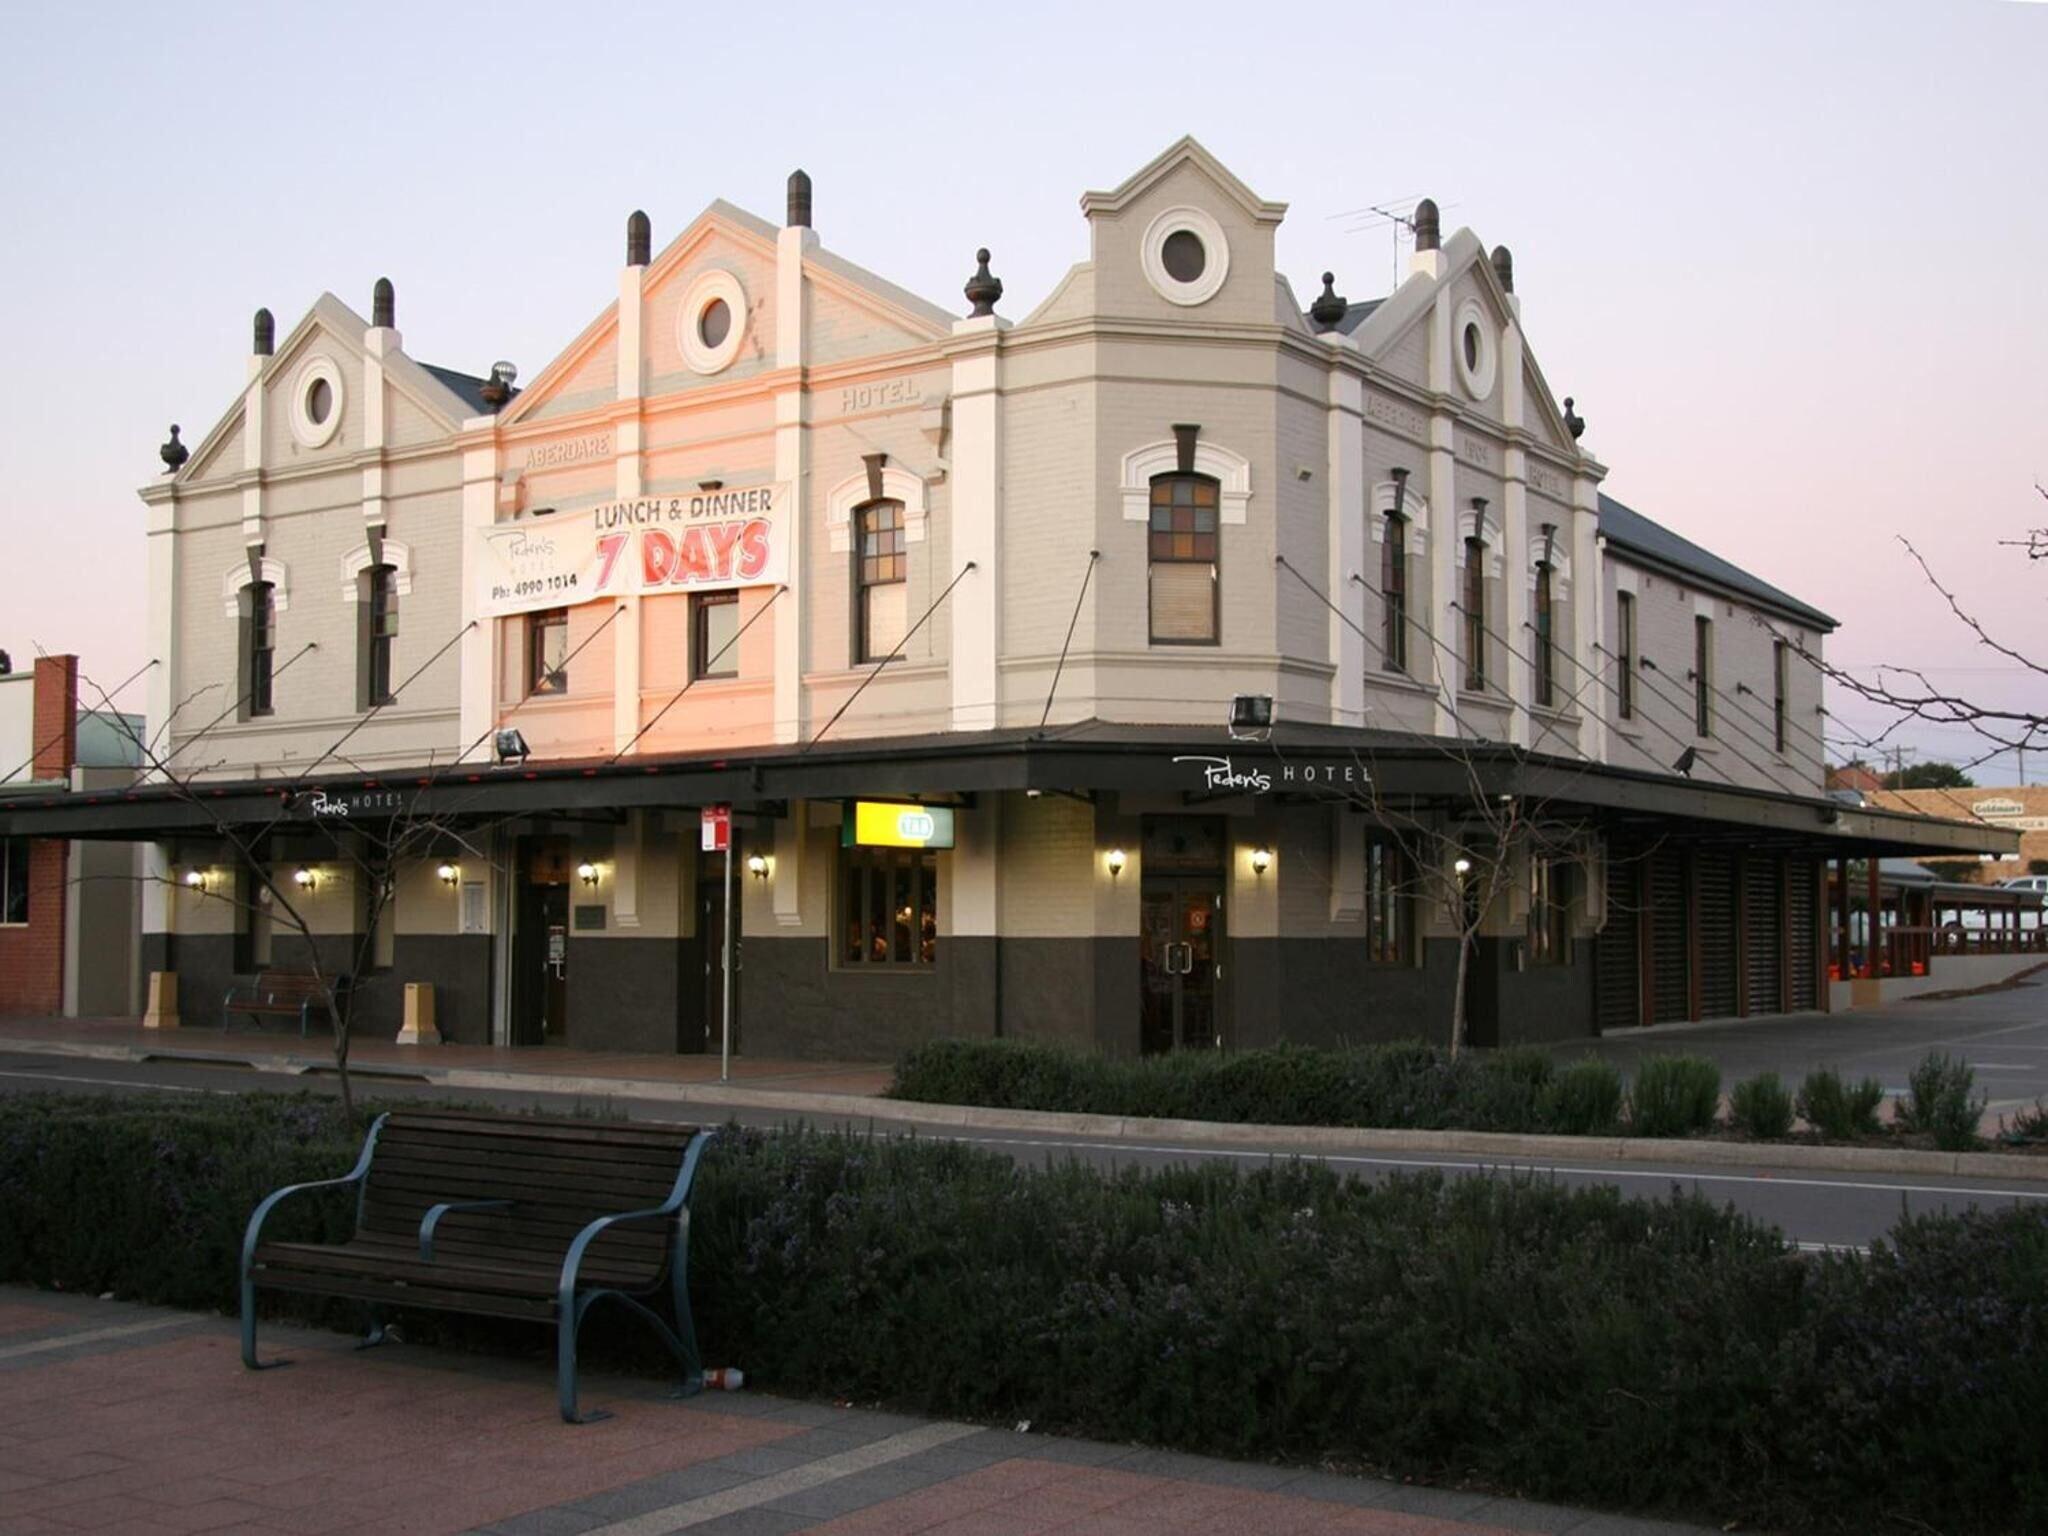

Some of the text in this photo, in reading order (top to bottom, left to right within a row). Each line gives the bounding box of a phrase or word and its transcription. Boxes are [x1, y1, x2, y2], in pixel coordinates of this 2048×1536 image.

[842, 376, 921, 415] HOTEL
[526, 432, 611, 468] ABERDARE
[594, 488, 772, 530] LUNCH & DINNER
[595, 516, 772, 592] 7 DAYS
[514, 579, 543, 596] 4990
[547, 572, 578, 590] 1014
[1283, 765, 1374, 782] HOTEL
